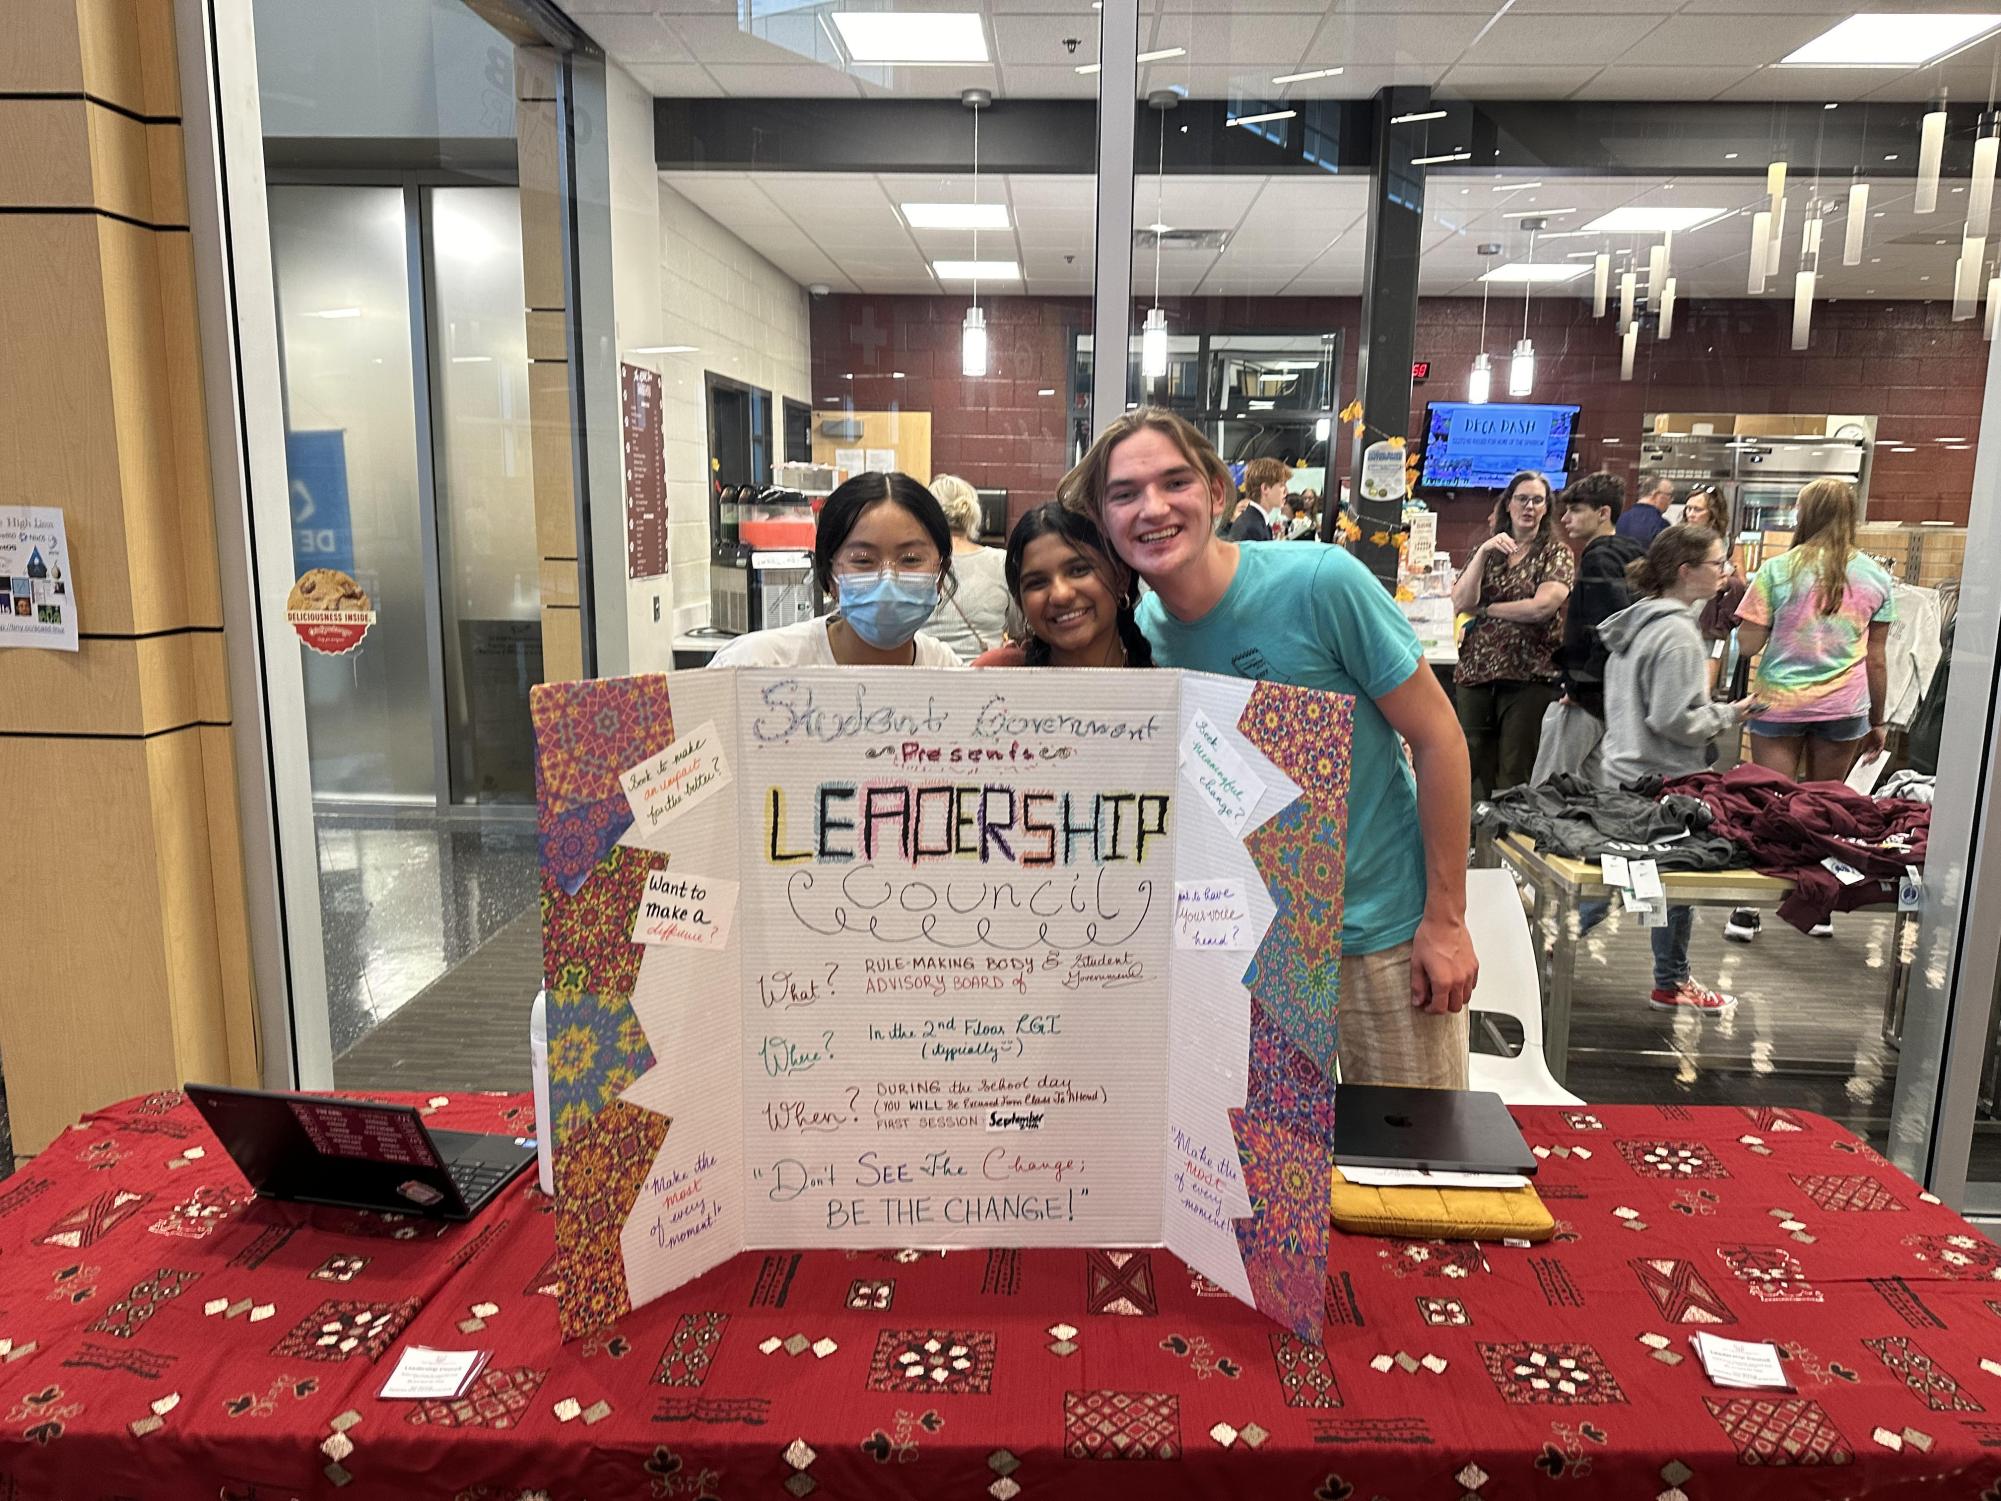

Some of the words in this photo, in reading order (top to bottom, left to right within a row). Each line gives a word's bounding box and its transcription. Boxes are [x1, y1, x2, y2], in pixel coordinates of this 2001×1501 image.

[1501, 419, 1536, 434] DASH
[287, 612, 342, 622] DELICIOUSNESS
[972, 694, 1160, 744] Government
[672, 738, 707, 765] make
[902, 740, 1035, 764] Presents
[643, 786, 658, 801] an
[659, 758, 701, 792] impact
[1192, 740, 1244, 802] meaningful
[1199, 775, 1246, 824] change?
[768, 783, 1171, 866] LEADERSHIP
[649, 874, 688, 898] Want
[690, 884, 707, 900] to
[842, 864, 1120, 919] Council
[1191, 890, 1201, 901] to
[1204, 886, 1235, 901] have
[645, 901, 688, 922] make
[693, 908, 711, 925] a
[1208, 907, 1244, 921] voice
[866, 957, 975, 973] RULE-MAKING
[986, 957, 1034, 973] BODY
[1070, 951, 1136, 969] Student
[757, 962, 840, 1009] What?
[866, 974, 946, 997] ADVISORY
[953, 975, 1004, 990] BOARD
[1012, 971, 1027, 996] of
[869, 1023, 884, 1041] In
[888, 1022, 916, 1040] the
[922, 1016, 956, 1039] 2nd
[964, 1018, 1005, 1036] Floor
[758, 1030, 835, 1077] Where?
[877, 1080, 941, 1096] DURING
[949, 1080, 971, 1094] the
[1037, 1074, 1072, 1094] day
[762, 1086, 860, 1131] When?
[873, 1099, 900, 1117] (YOU
[909, 1099, 942, 1111] WILL
[877, 1117, 910, 1131] FIRST
[988, 1110, 1045, 1128] September
[694, 1150, 717, 1174] the
[1217, 1158, 1237, 1180] the
[1184, 1159, 1227, 1193] most
[663, 1178, 702, 1210] most
[1174, 1171, 1185, 1192] of
[1192, 1183, 1222, 1217] every
[650, 1215, 665, 1248] of
[670, 1198, 706, 1224] every
[826, 1198, 871, 1229] BE
[879, 1196, 934, 1226] THE
